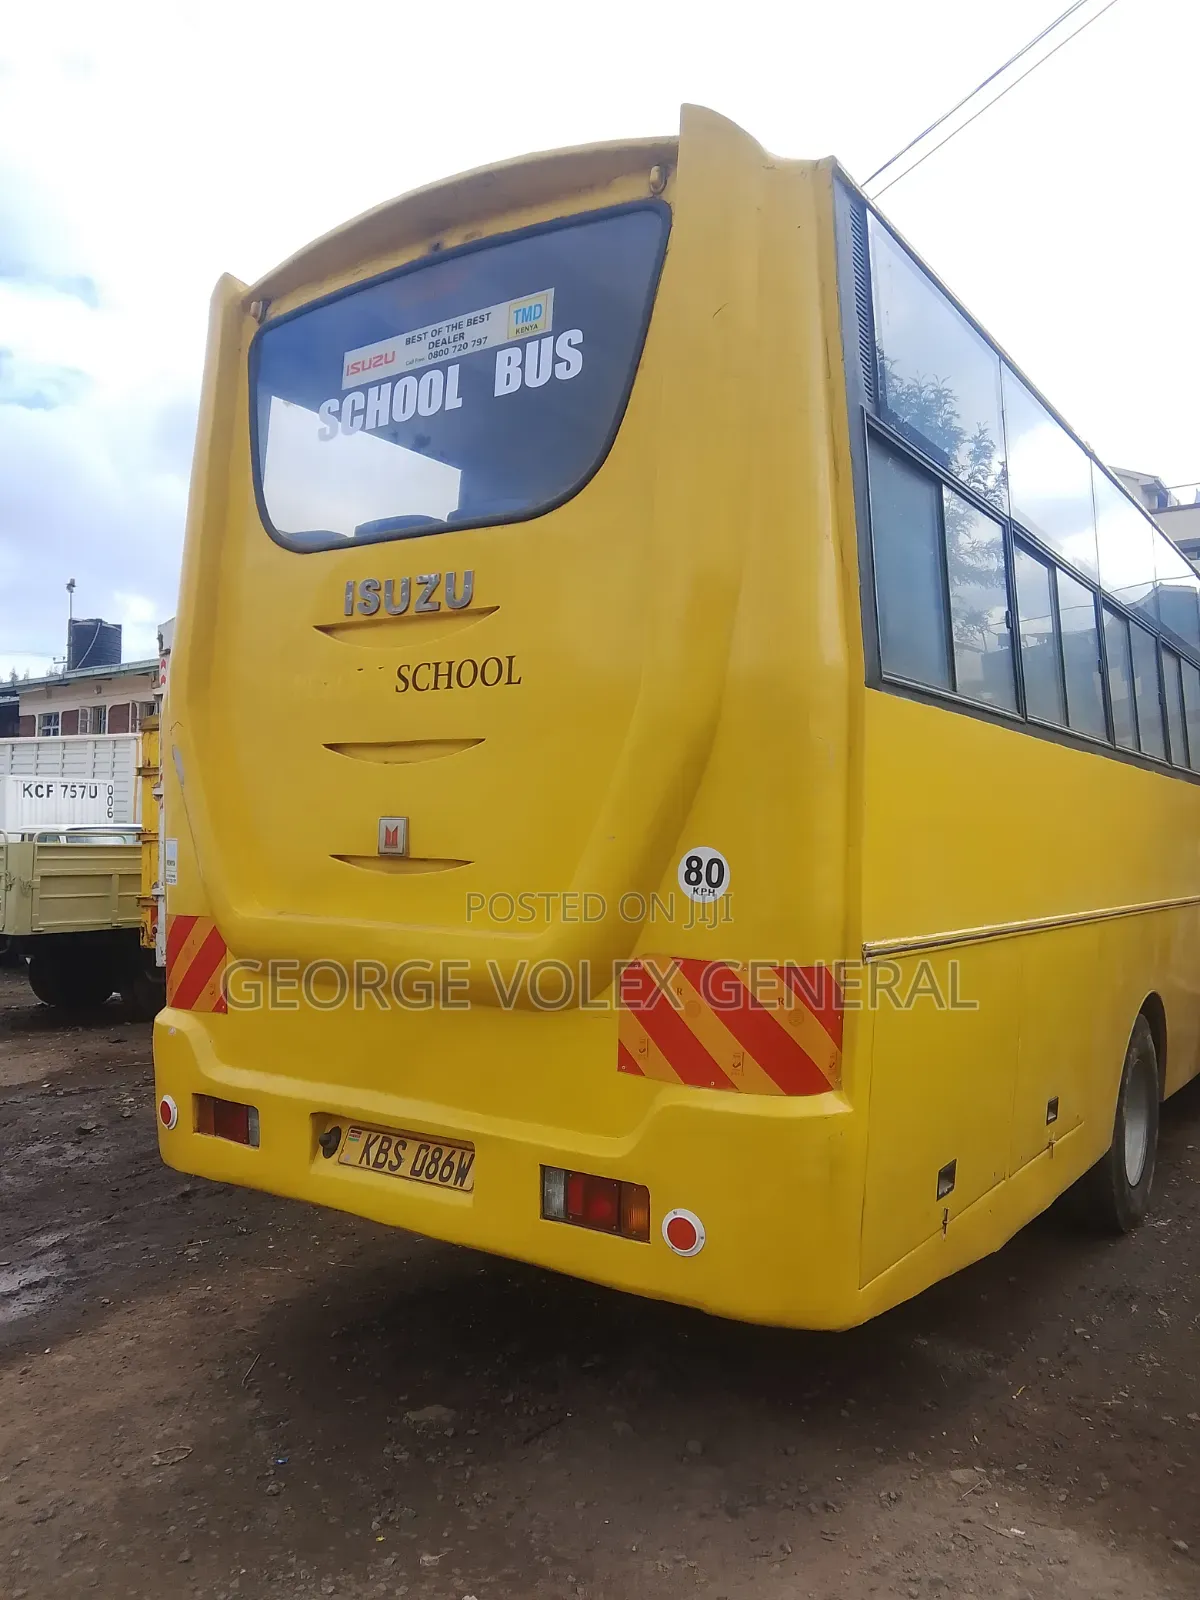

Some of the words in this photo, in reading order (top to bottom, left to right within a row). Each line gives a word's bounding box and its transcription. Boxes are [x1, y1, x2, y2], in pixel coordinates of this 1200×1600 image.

[513, 303, 543, 325] TMD
[405, 332, 428, 346] BEST
[430, 325, 443, 338] OF
[445, 321, 464, 333] THE
[466, 312, 492, 327] BEST
[428, 332, 465, 350] DEALER
[515, 323, 539, 335] KENYA
[427, 348, 450, 361] 0800
[452, 341, 469, 353] 720
[471, 336, 488, 348] 797
[346, 350, 396, 377] ISUZU
[317, 365, 463, 442] SCHOOL
[494, 328, 584, 397] BUS
[344, 570, 474, 616] ISUZU
[395, 655, 522, 693] SCHOOL
[22, 783, 54, 798] KCF
[60, 784, 98, 799] 757U
[683, 855, 725, 889] 80
[692, 886, 716, 897] KPH
[358, 1133, 408, 1172] KBS
[410, 1143, 475, 1187] 086W
